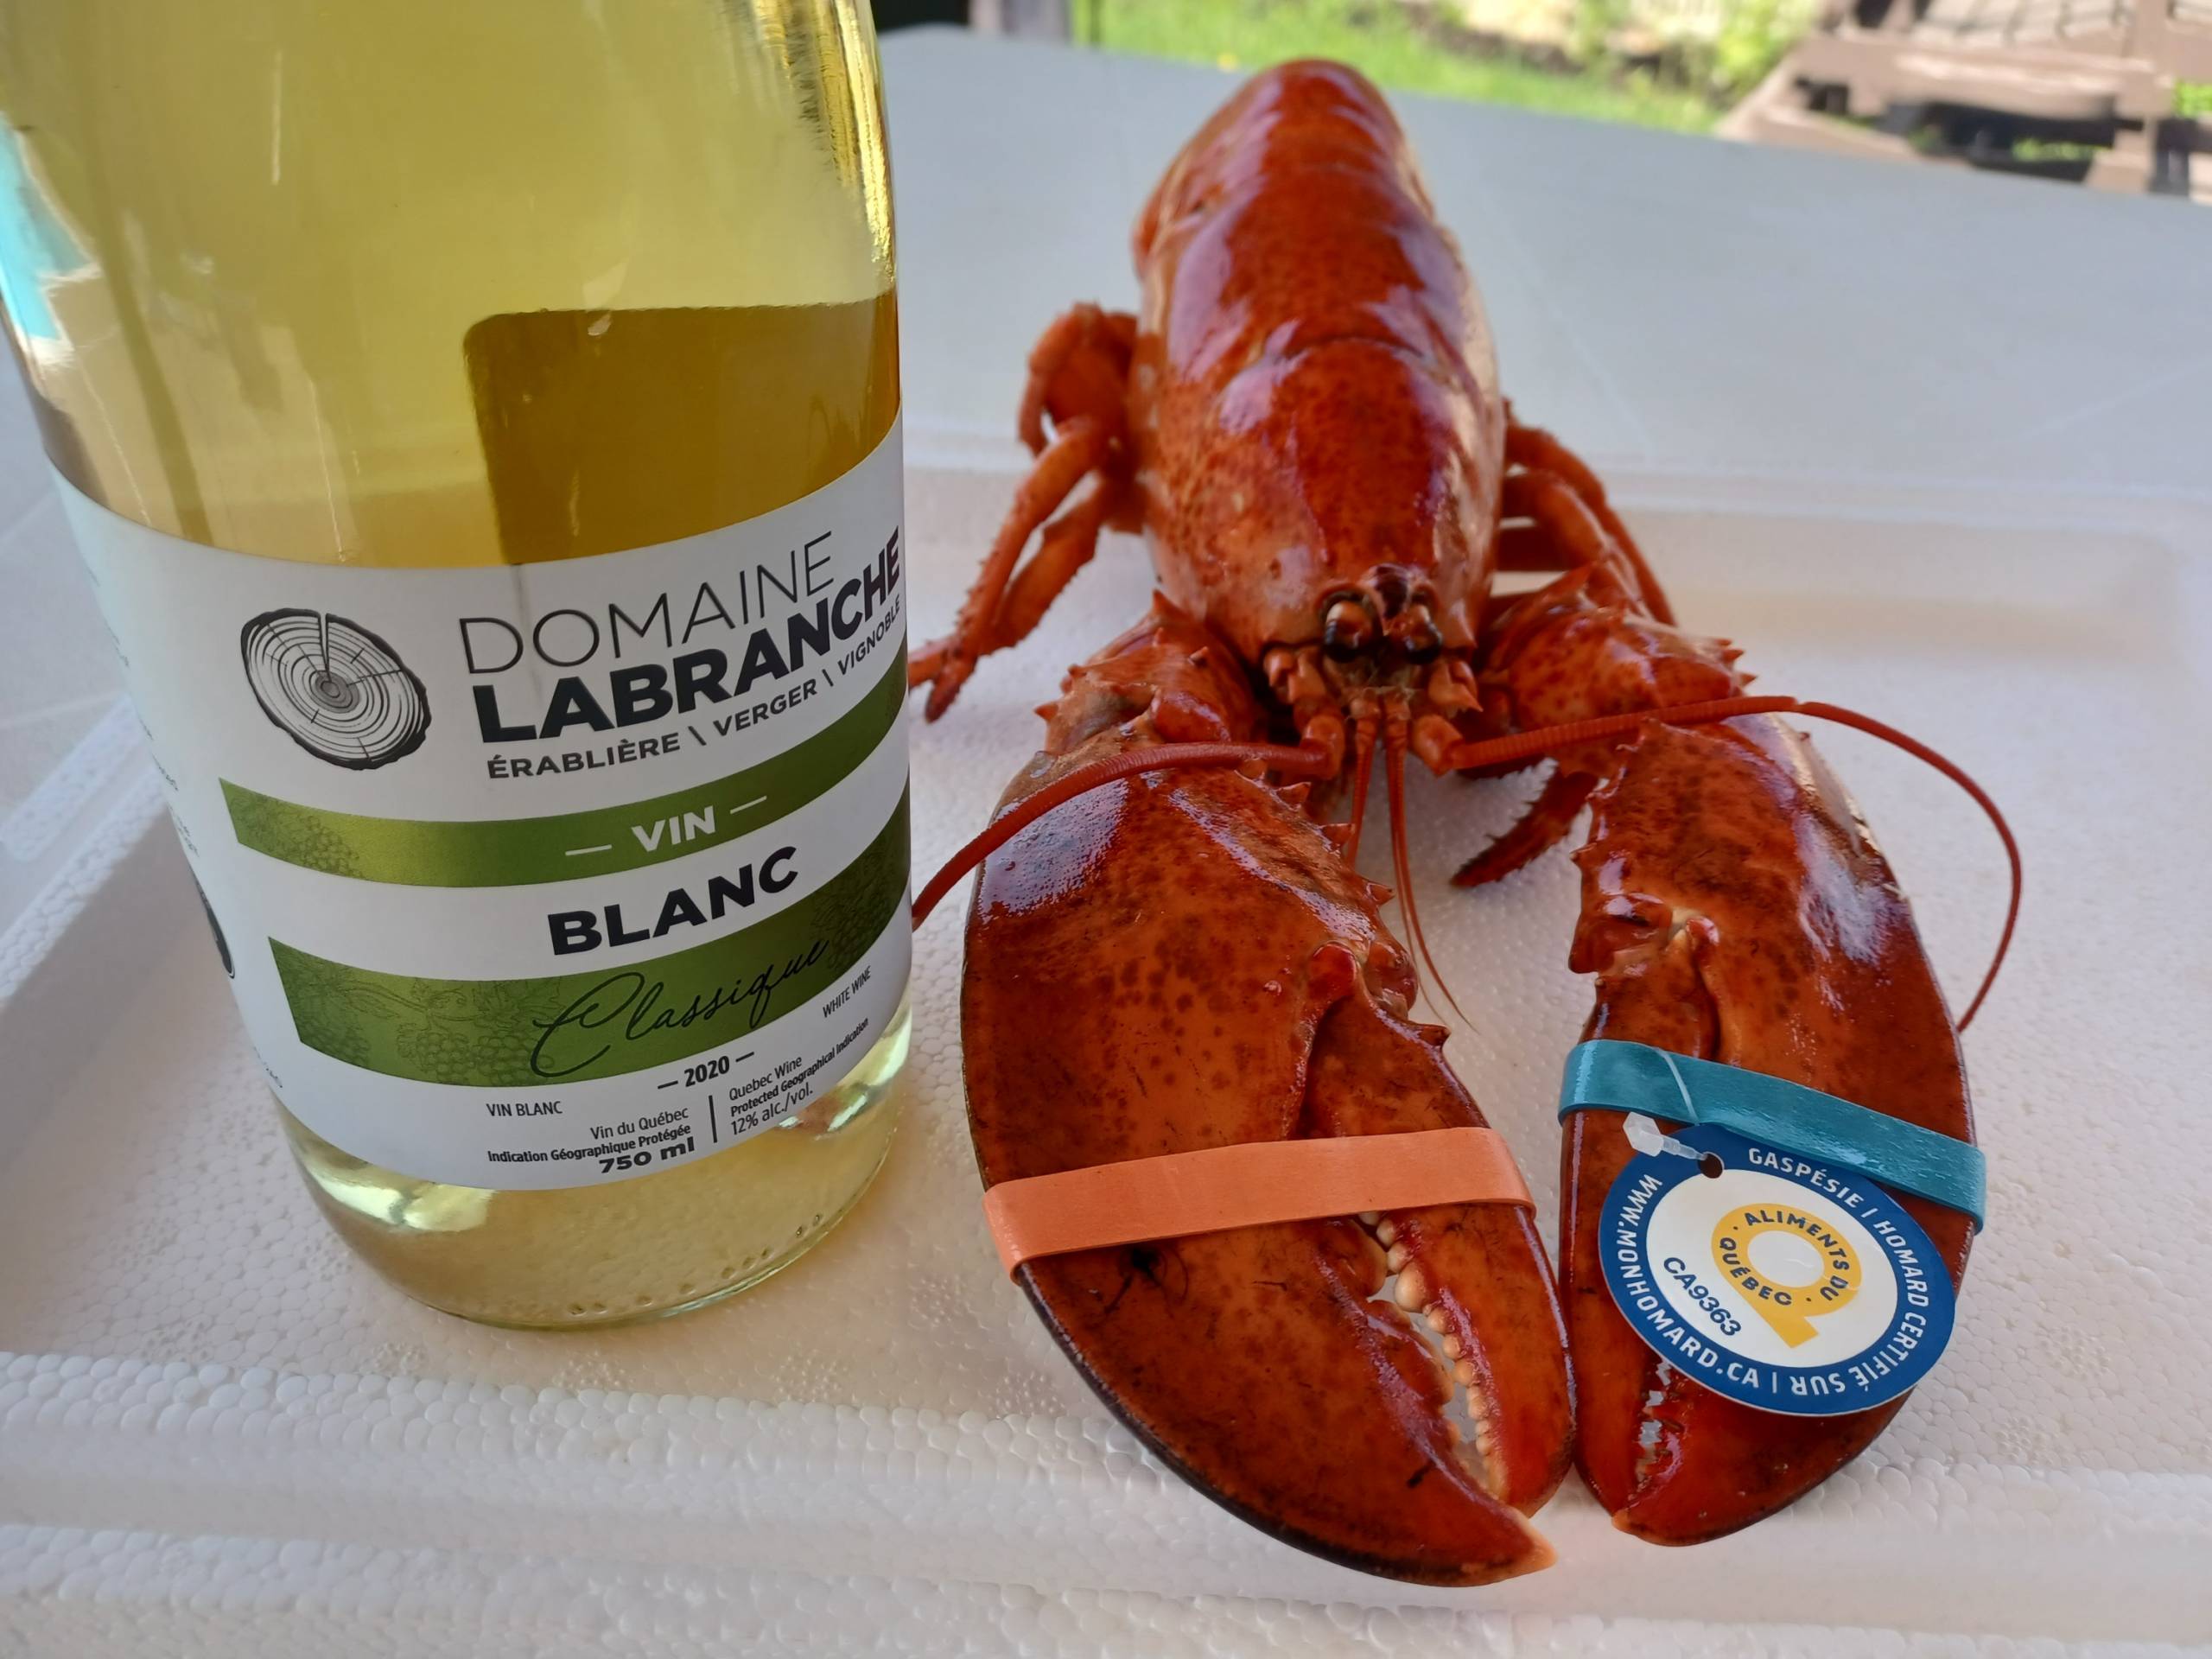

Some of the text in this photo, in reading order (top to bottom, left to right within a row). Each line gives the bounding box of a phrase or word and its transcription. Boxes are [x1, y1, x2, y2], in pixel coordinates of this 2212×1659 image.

[460, 531, 834, 674] DOMAINE
[472, 525, 900, 744] LABRANCHE
[487, 731, 680, 779] ÉRABLIÈRE
[713, 678, 817, 737] VERGER
[837, 593, 900, 676] VIGNOBLE
[632, 805, 716, 852] VIN
[548, 846, 798, 956] BLANC
[530, 940, 830, 1078] Classique
[823, 965, 872, 1018] WHITE WINE
[683, 1055, 731, 1087] 2020
[728, 1056, 803, 1102] Quebec Wine
[730, 1018, 869, 1117] Protected Geographical Indication
[486, 1101, 563, 1117] VIN BLANC
[487, 1125, 691, 1163] Indication Géographique Protégée
[590, 1108, 690, 1140] Vin du Québec
[731, 1114, 760, 1136] 12%
[598, 1136, 696, 1173] 750 ml
[1749, 1147, 1865, 1211] GASPÉSIE
[1616, 1174, 1761, 1389] WWW.MONHOMARD.CA
[1719, 1210, 1851, 1306] ALIMENTS DU QUÉBEC
[1873, 1220, 1929, 1307] HOMARD
[1663, 1256, 1742, 1337] CA9363
[1790, 1371, 1847, 1396] SUR
[1852, 1313, 1928, 1392] CERTIFIÉ
